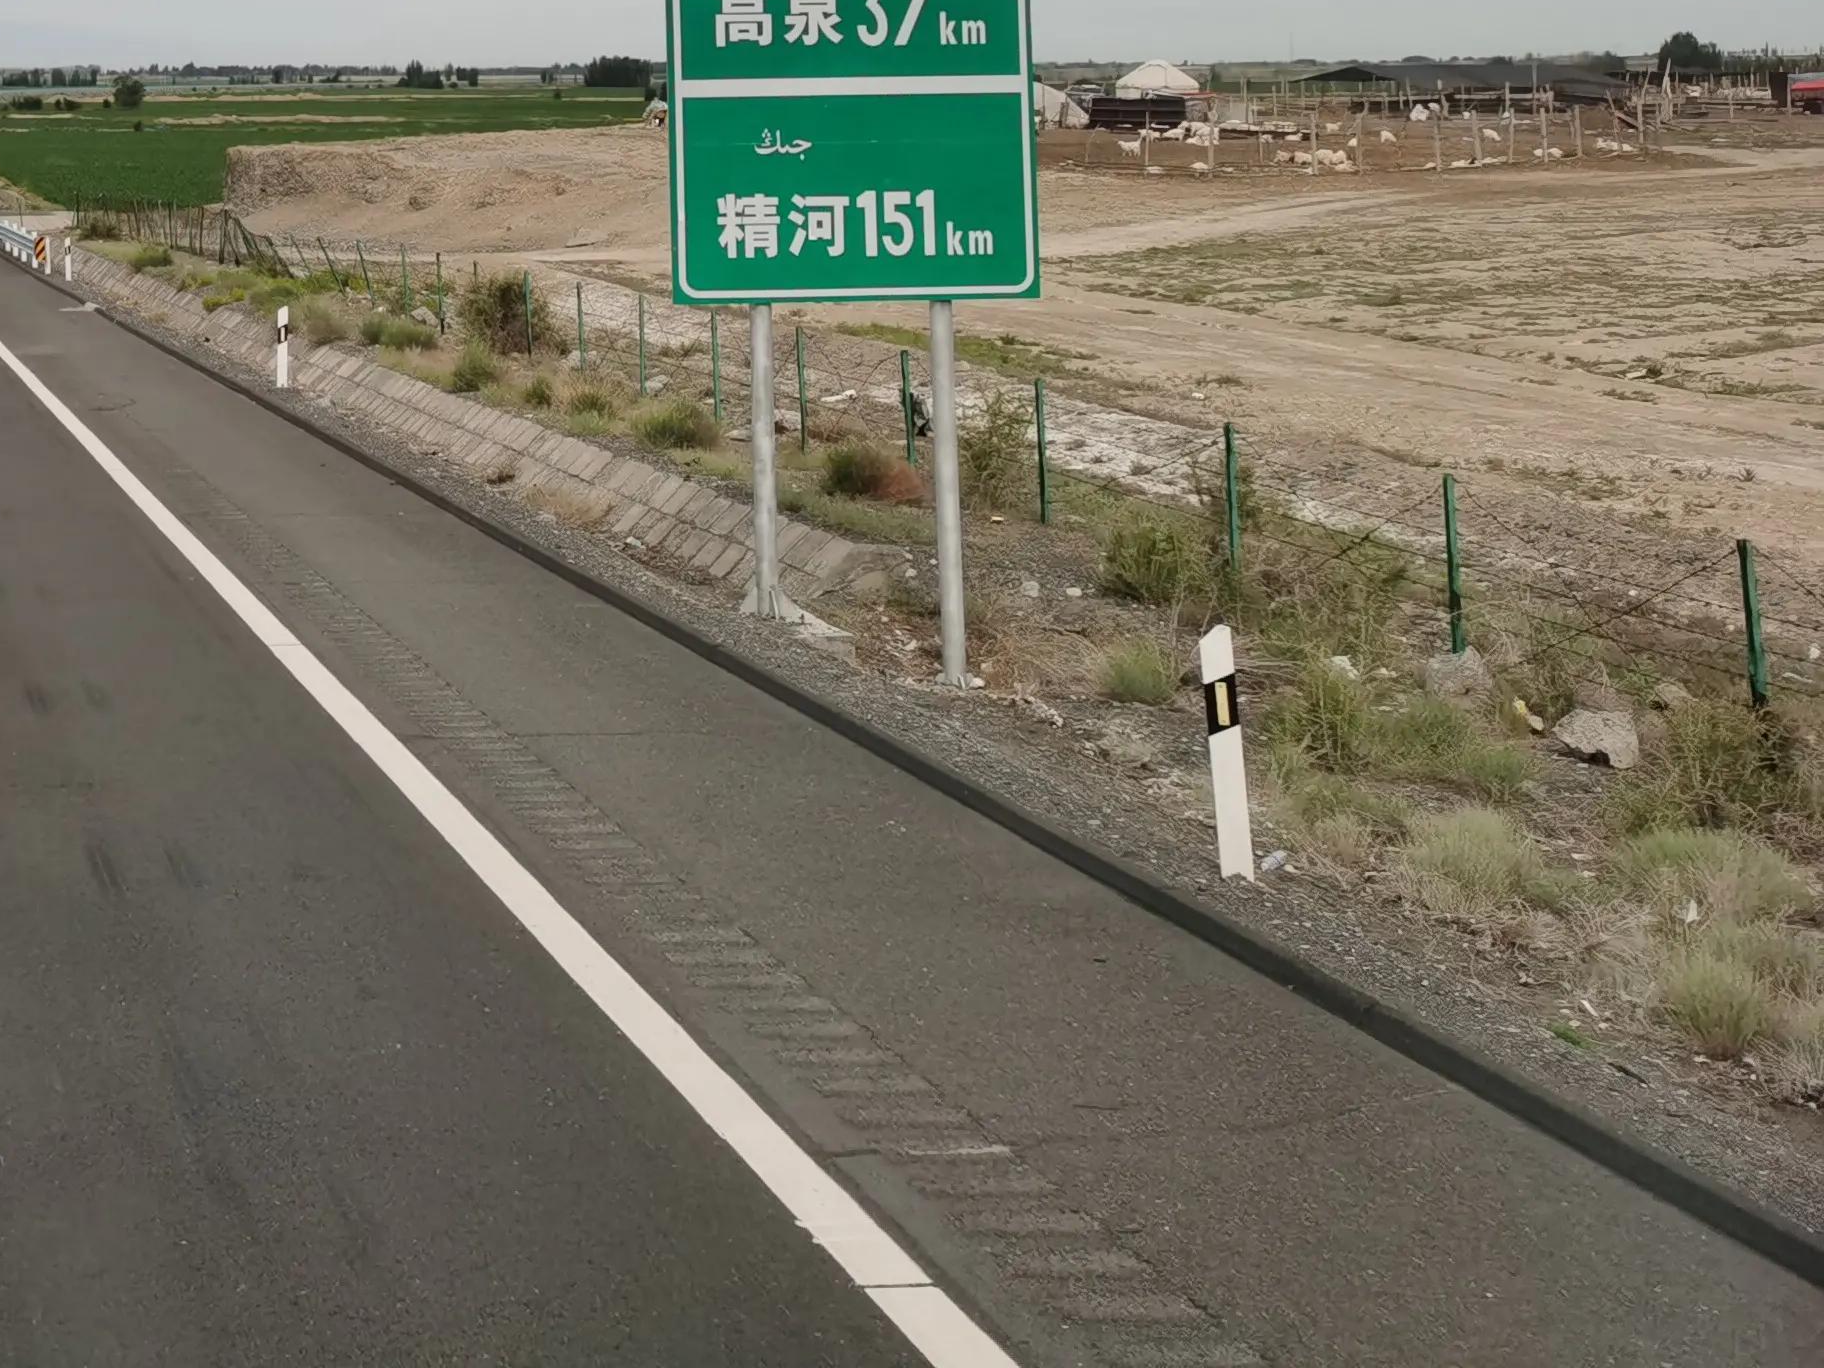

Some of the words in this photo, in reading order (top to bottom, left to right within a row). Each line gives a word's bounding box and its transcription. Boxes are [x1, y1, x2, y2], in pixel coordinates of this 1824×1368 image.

[939, 11, 987, 46] km
[716, 192, 850, 259] 精河
[855, 189, 936, 258] 151
[946, 222, 994, 256] km
